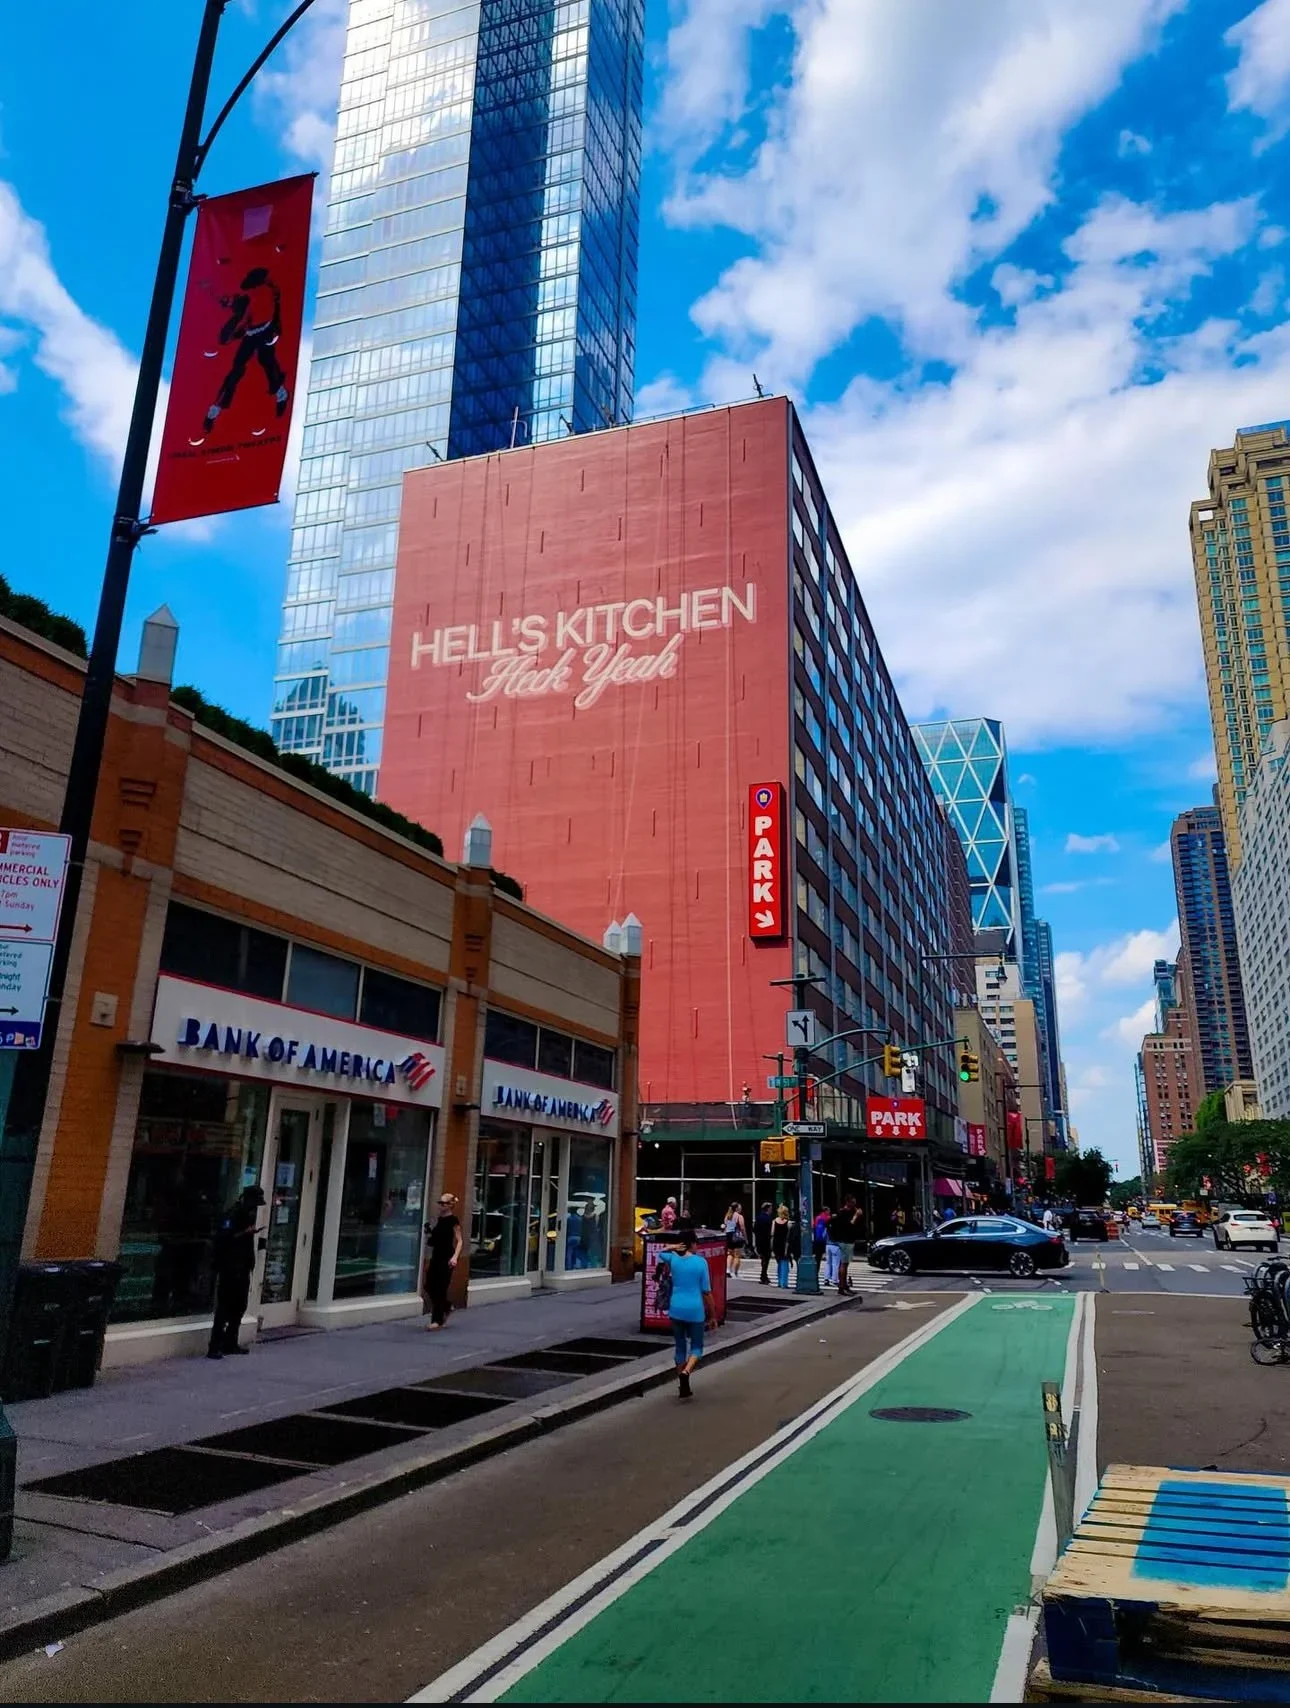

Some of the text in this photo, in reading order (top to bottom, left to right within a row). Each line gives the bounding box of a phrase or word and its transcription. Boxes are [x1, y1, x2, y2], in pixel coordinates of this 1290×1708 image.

[410, 581, 757, 670] HELL'S KITCHEN
[466, 632, 684, 711] Heck Yeah
[752, 815, 775, 903] PARK
[32, 877, 60, 888] ONLY
[5, 899, 35, 911] Sunday
[178, 1017, 396, 1086] BANK OF AMERICA
[493, 1085, 596, 1124] BANK OF AMERICA
[870, 1110, 923, 1126] PARK
[787, 1125, 801, 1133] ONE
